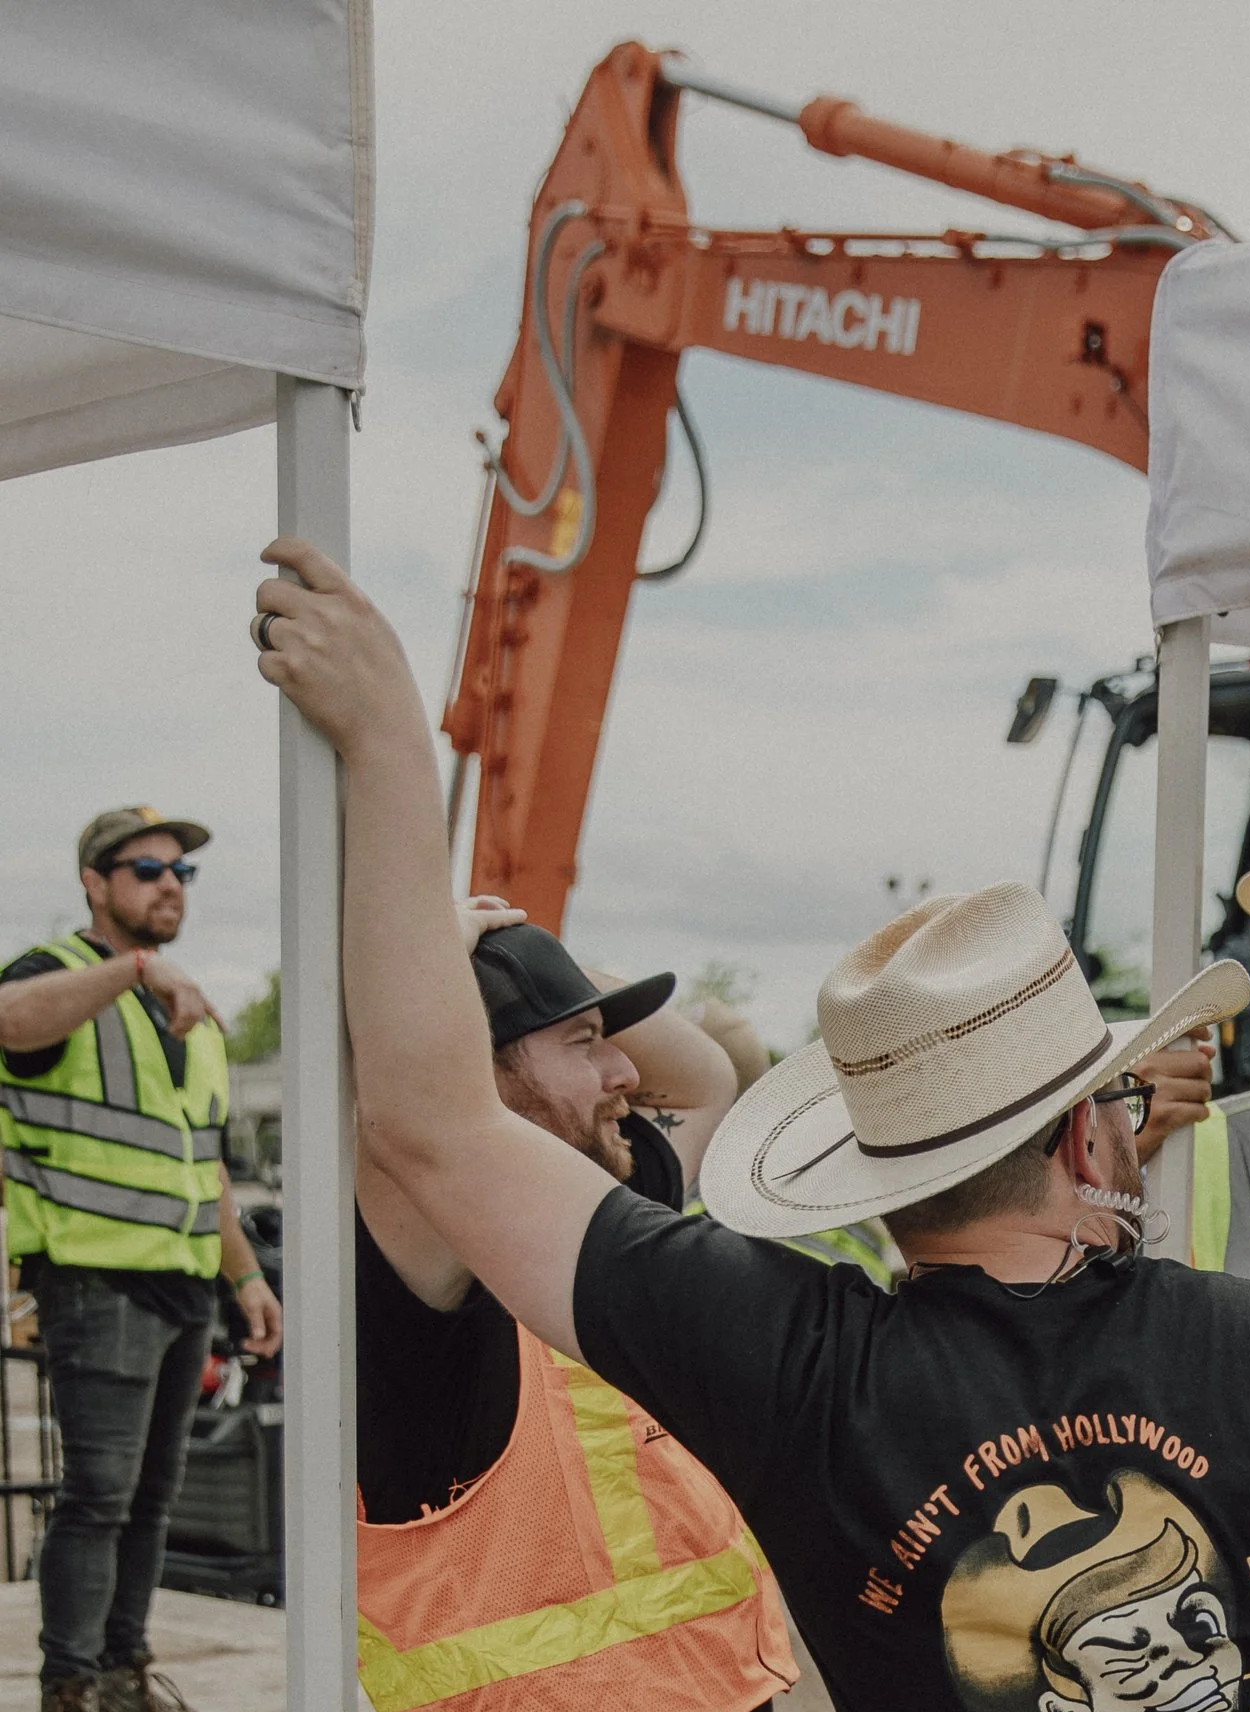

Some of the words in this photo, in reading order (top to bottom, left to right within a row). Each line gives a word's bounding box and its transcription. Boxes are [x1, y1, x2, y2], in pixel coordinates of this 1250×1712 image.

[723, 276, 922, 356] HITACHI
[858, 1567, 903, 1614] WE
[890, 1484, 960, 1570] AIN'T
[963, 1424, 1049, 1490] FROM
[1052, 1413, 1209, 1479] HOLLYWOOD
